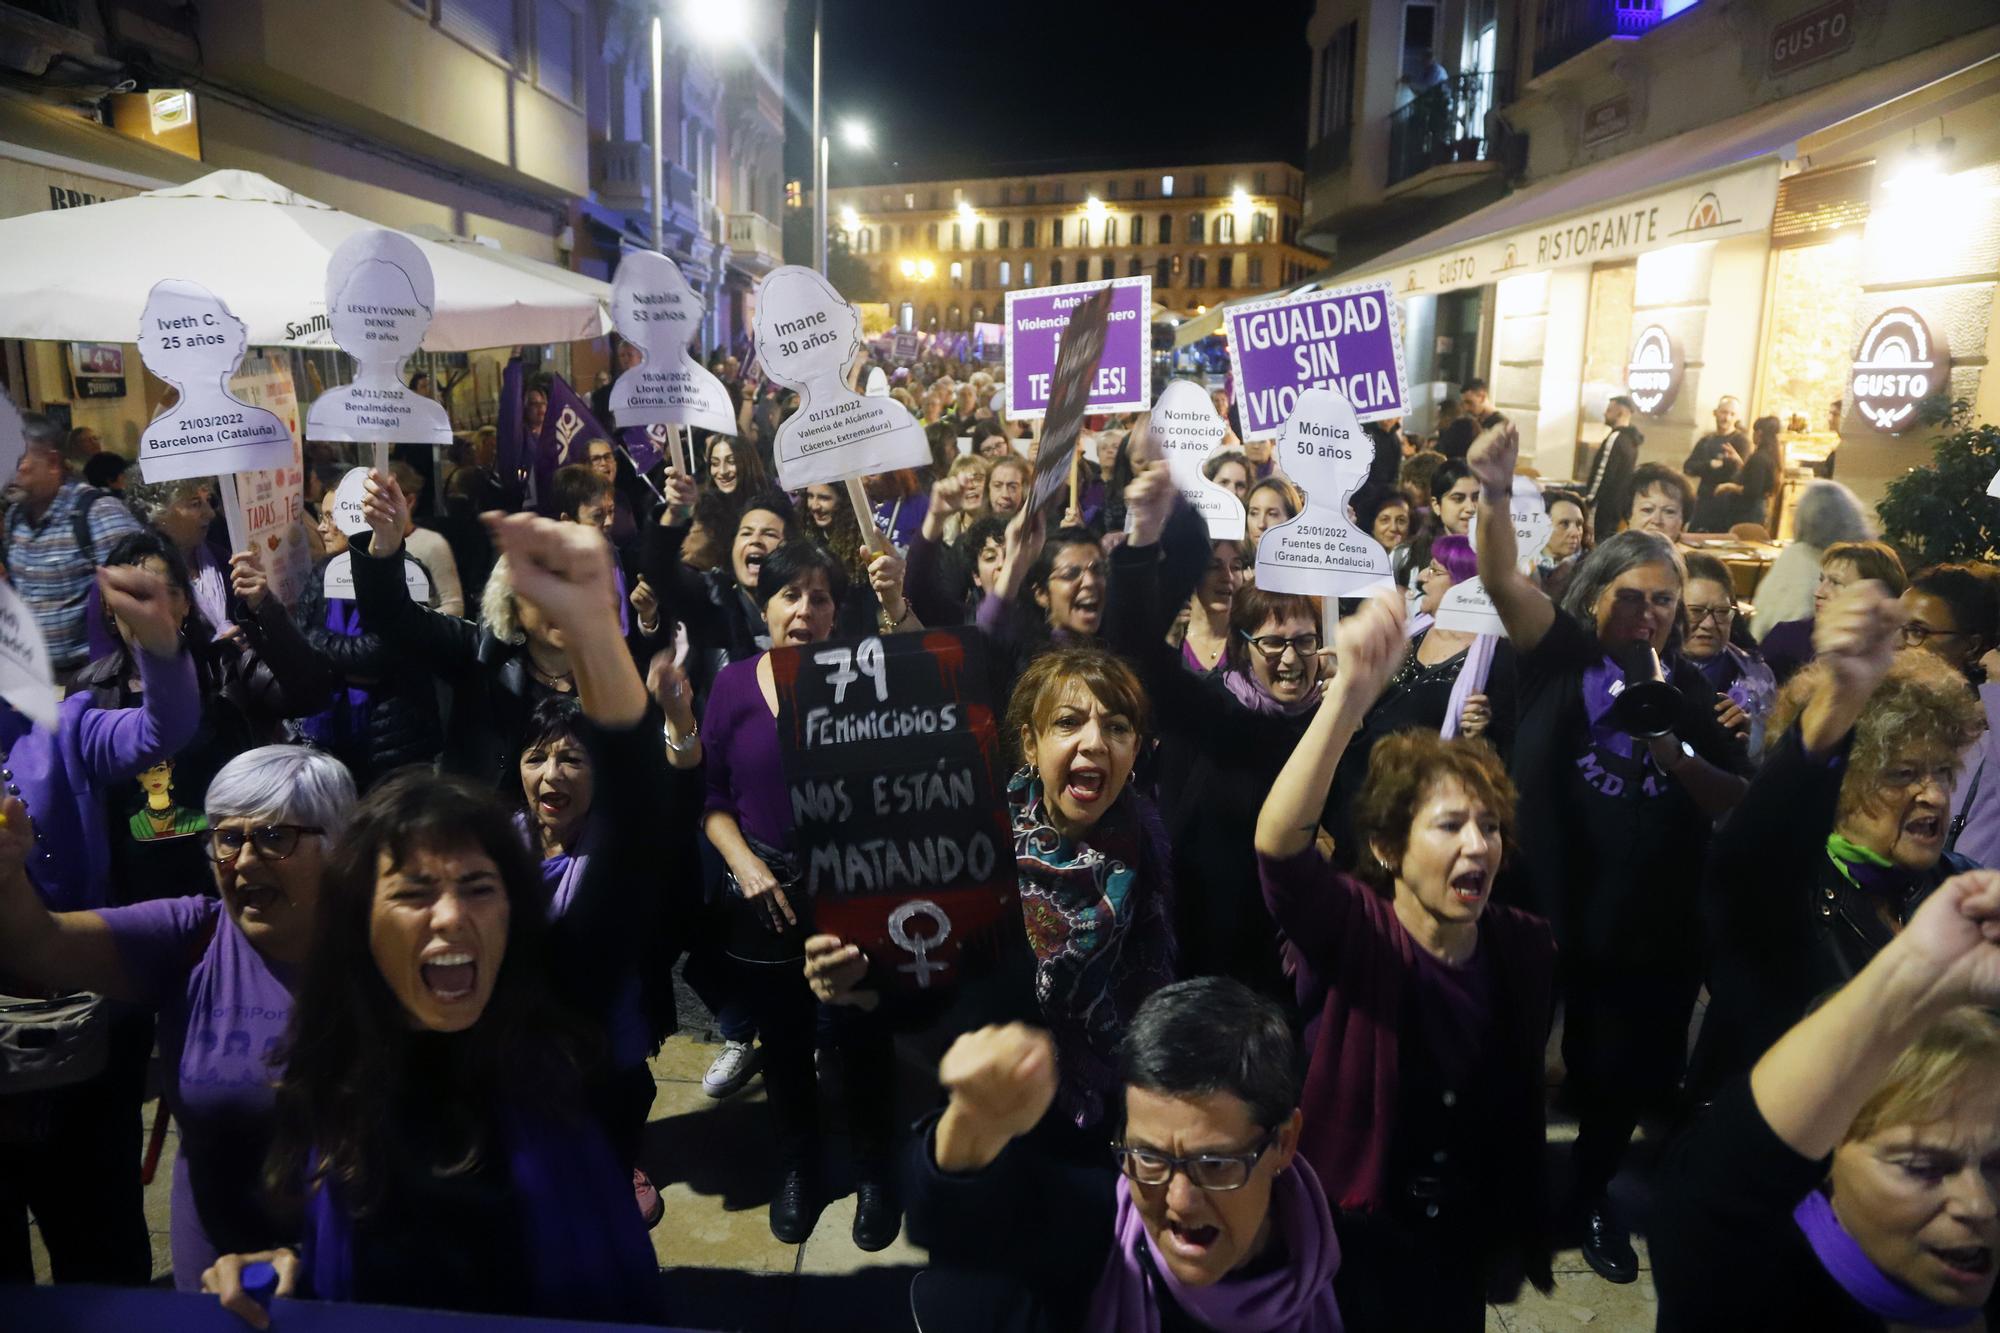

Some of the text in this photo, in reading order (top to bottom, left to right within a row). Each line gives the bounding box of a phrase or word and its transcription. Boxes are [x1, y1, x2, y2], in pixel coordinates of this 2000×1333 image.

[1773, 12, 1848, 61] GUSTO
[1437, 207, 1660, 285] GUSTO RISTORANTE
[632, 291, 681, 305] Natalia
[1052, 295, 1082, 310] Ante
[347, 304, 416, 318] LESLEY IVONNE
[633, 309, 687, 321] 53 años
[157, 313, 221, 331] Iveth C.
[364, 318, 396, 328] DENISE
[773, 311, 827, 337] Imane
[1017, 310, 1136, 331] Violencia nero
[1240, 296, 1382, 352] IGUALDAD
[161, 334, 225, 349] 25 años
[378, 333, 400, 341] años
[779, 329, 838, 357] 30 años
[1294, 340, 1340, 381] SIN
[351, 388, 404, 399] 04/11/2022
[635, 385, 700, 394] Lloret del Mar
[1853, 373, 1928, 398] GUSTO
[627, 396, 666, 408] (Girona,
[809, 400, 862, 422] 01/11/2022
[179, 413, 244, 431] 21/03/2022
[797, 408, 884, 438] Valencia de Alcántara
[1164, 410, 1211, 421] Nombre
[149, 425, 277, 450] Barcelona (Cataluña)
[800, 419, 892, 454] (Cáceres, Extremadura)
[1151, 425, 1224, 437] no conocido
[1299, 421, 1350, 440] Mónica
[1162, 440, 1209, 451] 44 años
[1297, 442, 1352, 460] 50 años
[247, 501, 276, 531] TAPAS
[349, 514, 361, 523] 18
[1297, 525, 1347, 538] 25/01/2022
[1282, 538, 1367, 554] Fuentes de Cesna
[1274, 551, 1323, 565] (Granada,
[1456, 595, 1486, 605] Sevilla
[813, 636, 889, 704] 79
[790, 757, 975, 826] NOS ESTÁN
[807, 831, 995, 897] MATANDO
